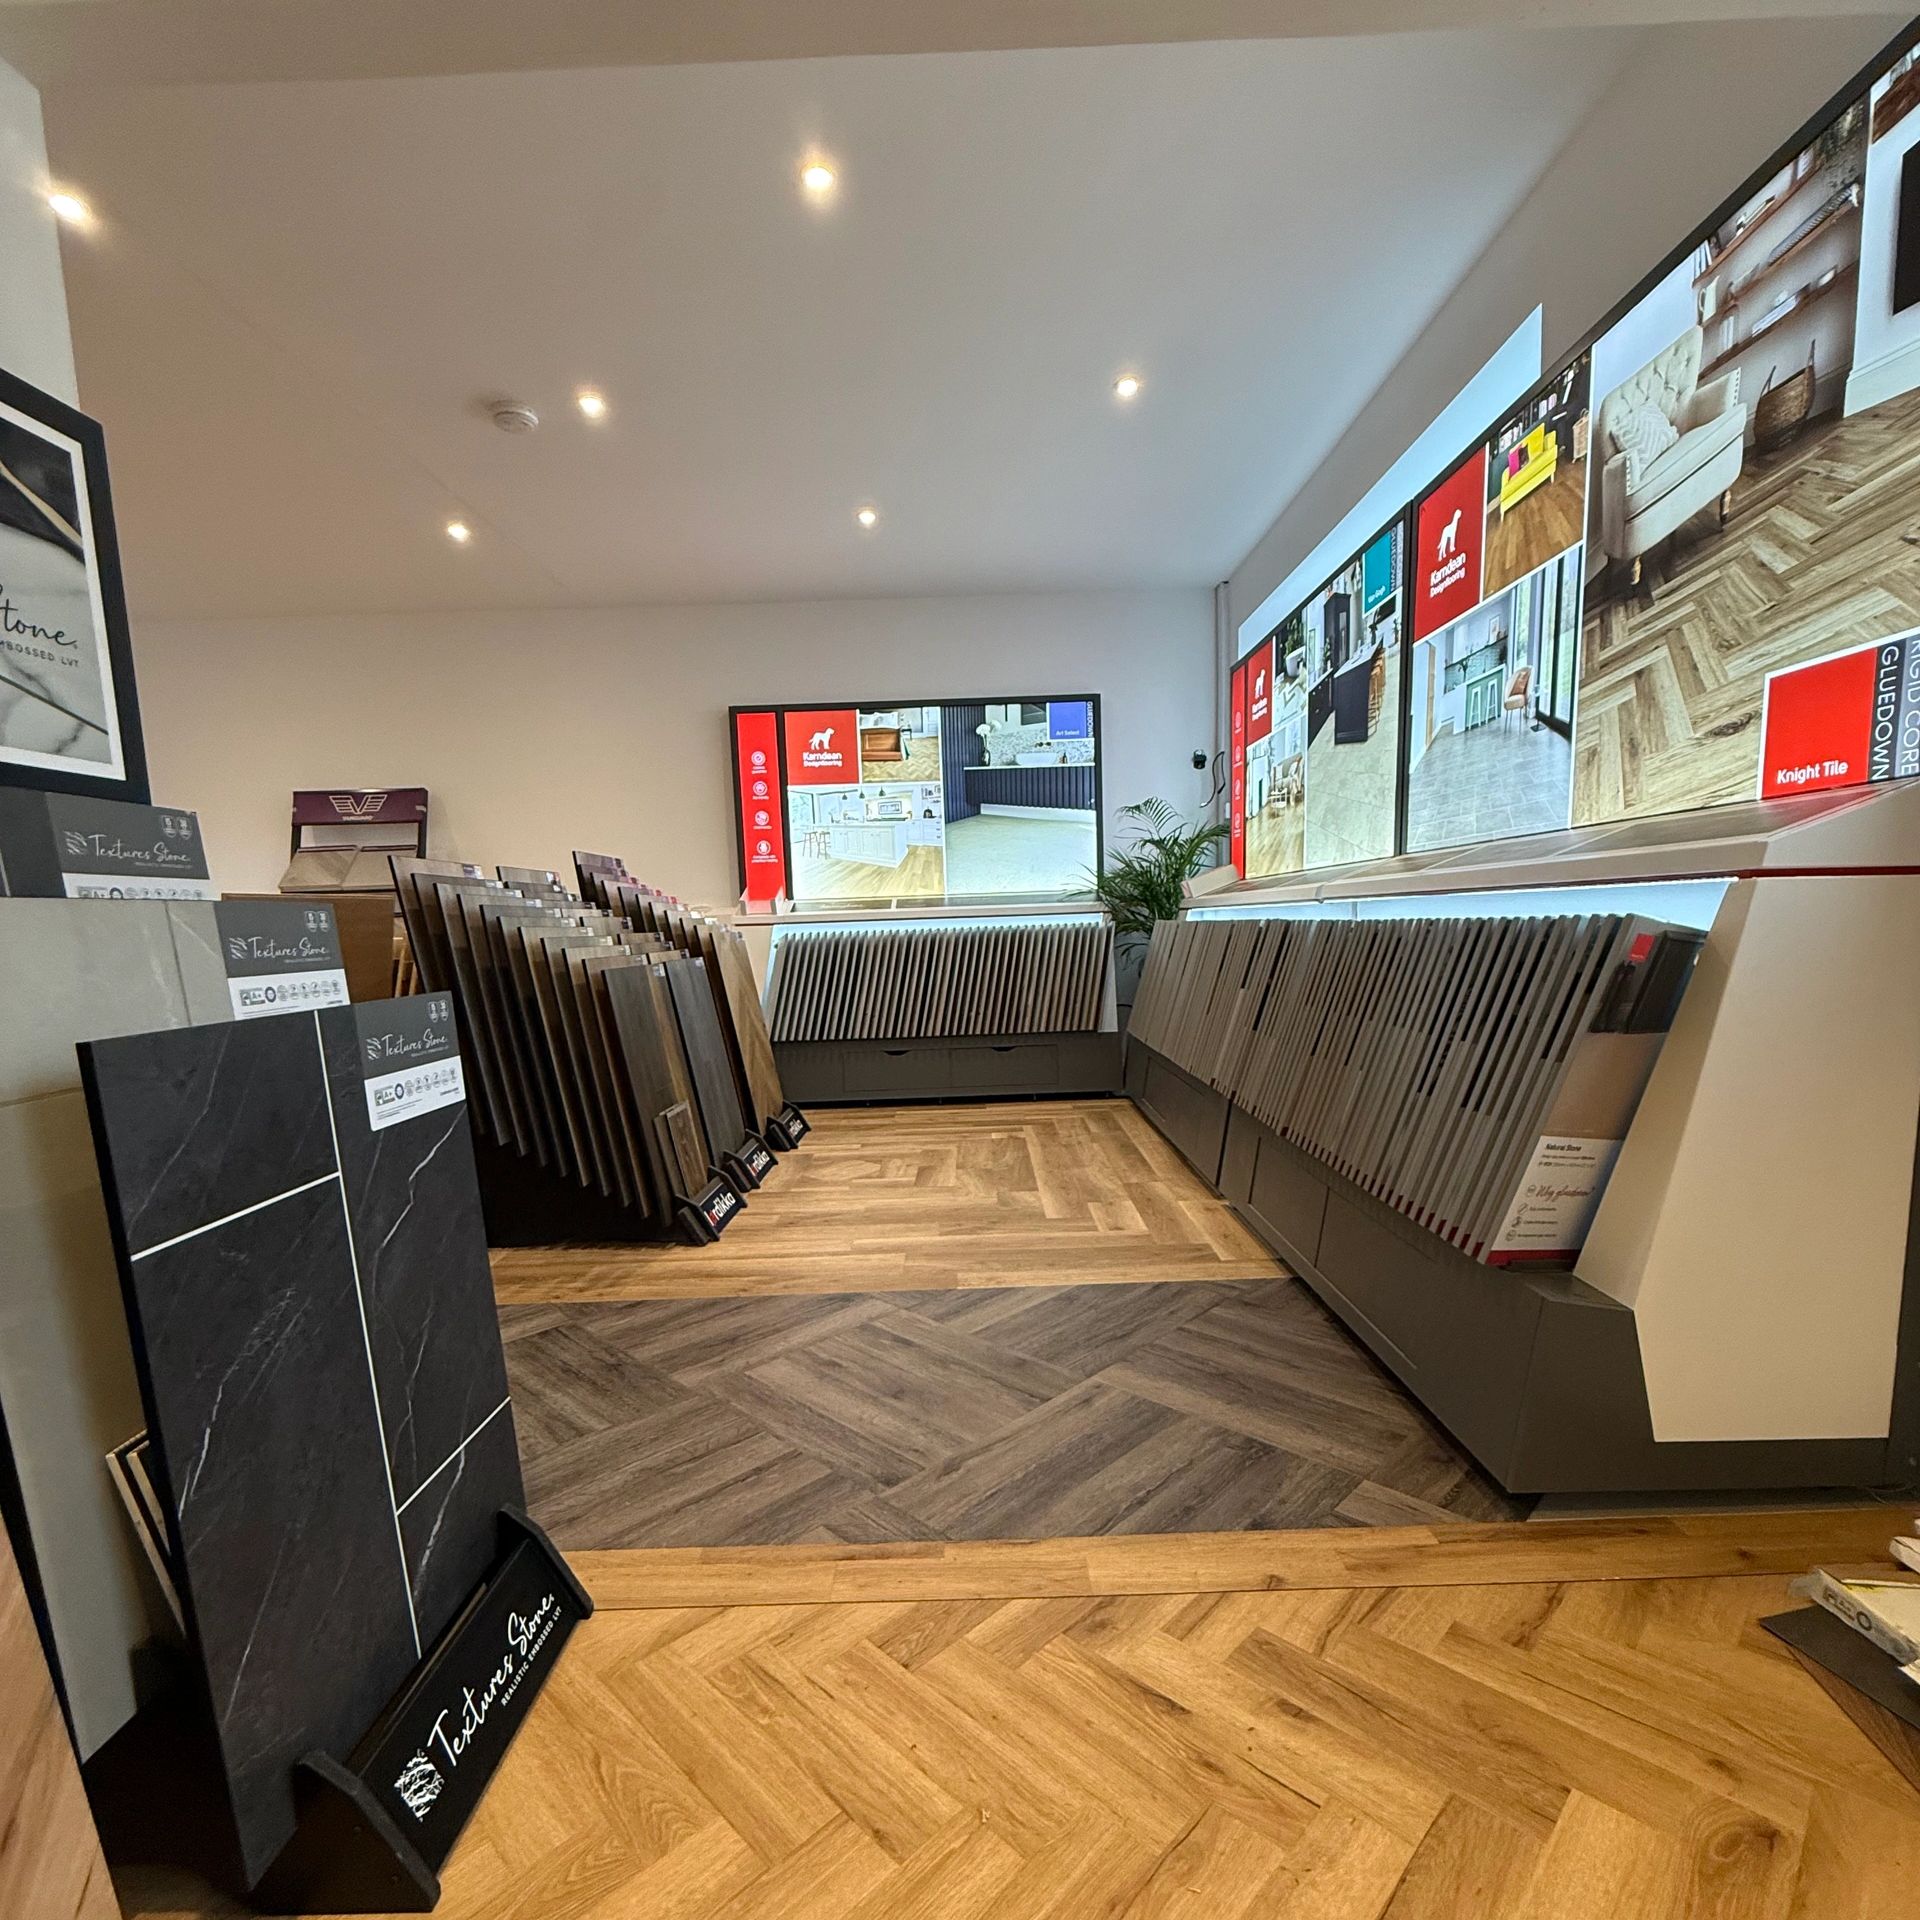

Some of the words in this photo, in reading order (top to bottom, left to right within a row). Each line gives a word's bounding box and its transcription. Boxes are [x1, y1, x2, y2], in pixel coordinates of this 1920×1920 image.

[1430, 552, 1466, 586] Karndean
[0, 585, 78, 646] tone
[0, 639, 55, 662] BOSSED
[61, 656, 79, 667] LVT
[1871, 645, 1900, 781] GLUEDOWN
[802, 752, 842, 761] Karndean
[1901, 710, 1920, 775] CORE
[1777, 764, 1820, 784] Knight
[1822, 760, 1848, 776] Tile
[87, 834, 150, 860] Textures
[153, 841, 190, 862] Stone
[248, 936, 297, 959] Textures
[298, 937, 329, 957] Stone
[381, 1033, 421, 1056] Textures
[423, 1028, 448, 1049] Stone
[1545, 1143, 1565, 1151] Natural
[501, 1661, 529, 1706] REALISTIC
[528, 1620, 554, 1661] EMBOSSED
[552, 1606, 562, 1621] LVT
[426, 1652, 513, 1767] Textures
[507, 1593, 555, 1656] Stone
